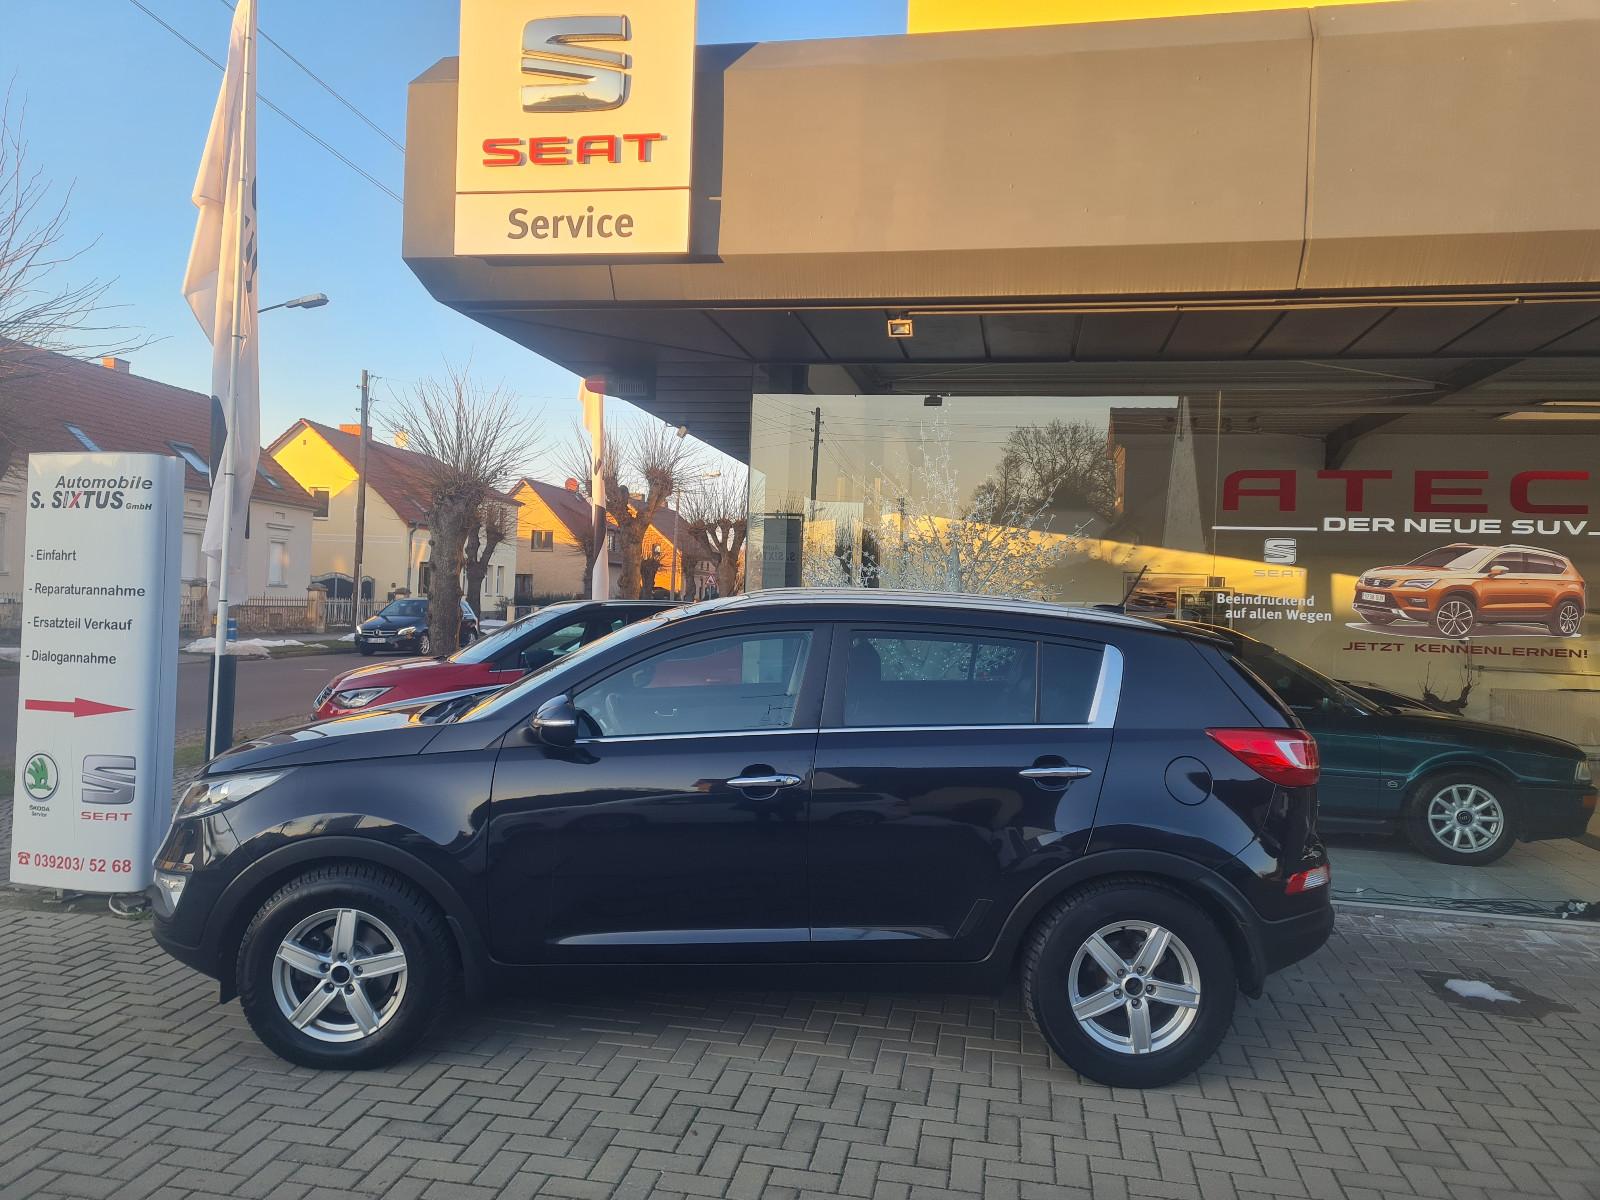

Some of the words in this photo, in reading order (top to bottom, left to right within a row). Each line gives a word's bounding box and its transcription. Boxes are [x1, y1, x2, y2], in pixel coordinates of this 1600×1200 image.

[482, 133, 664, 167] SEAT
[507, 206, 634, 239] Service
[55, 475, 153, 490] Automobile
[30, 490, 45, 509] S.
[52, 490, 124, 509] SIXTUS
[125, 502, 153, 511] GmbH
[1323, 517, 1395, 533] DER
[1404, 518, 1502, 534] NEUE
[1511, 519, 1588, 535] SUV
[36, 549, 77, 561] Einfahrt
[1253, 569, 1305, 577] SEAT
[34, 583, 146, 597] Reparaturannahme
[1216, 593, 1315, 606] Beeindruckend
[33, 616, 81, 630] Ersatzteil
[84, 617, 133, 631] Verkauf
[1225, 607, 1247, 619] auf
[1249, 608, 1282, 620] allen
[1286, 609, 1332, 624] Wegen
[31, 650, 117, 666] Dialogannahme
[1342, 642, 1405, 652] JETZT
[1414, 643, 1589, 659] KENNENLERNEN!
[80, 811, 133, 822] SEAT
[34, 853, 85, 872] 039203/
[89, 858, 106, 873] 52
[111, 859, 132, 873] 68
